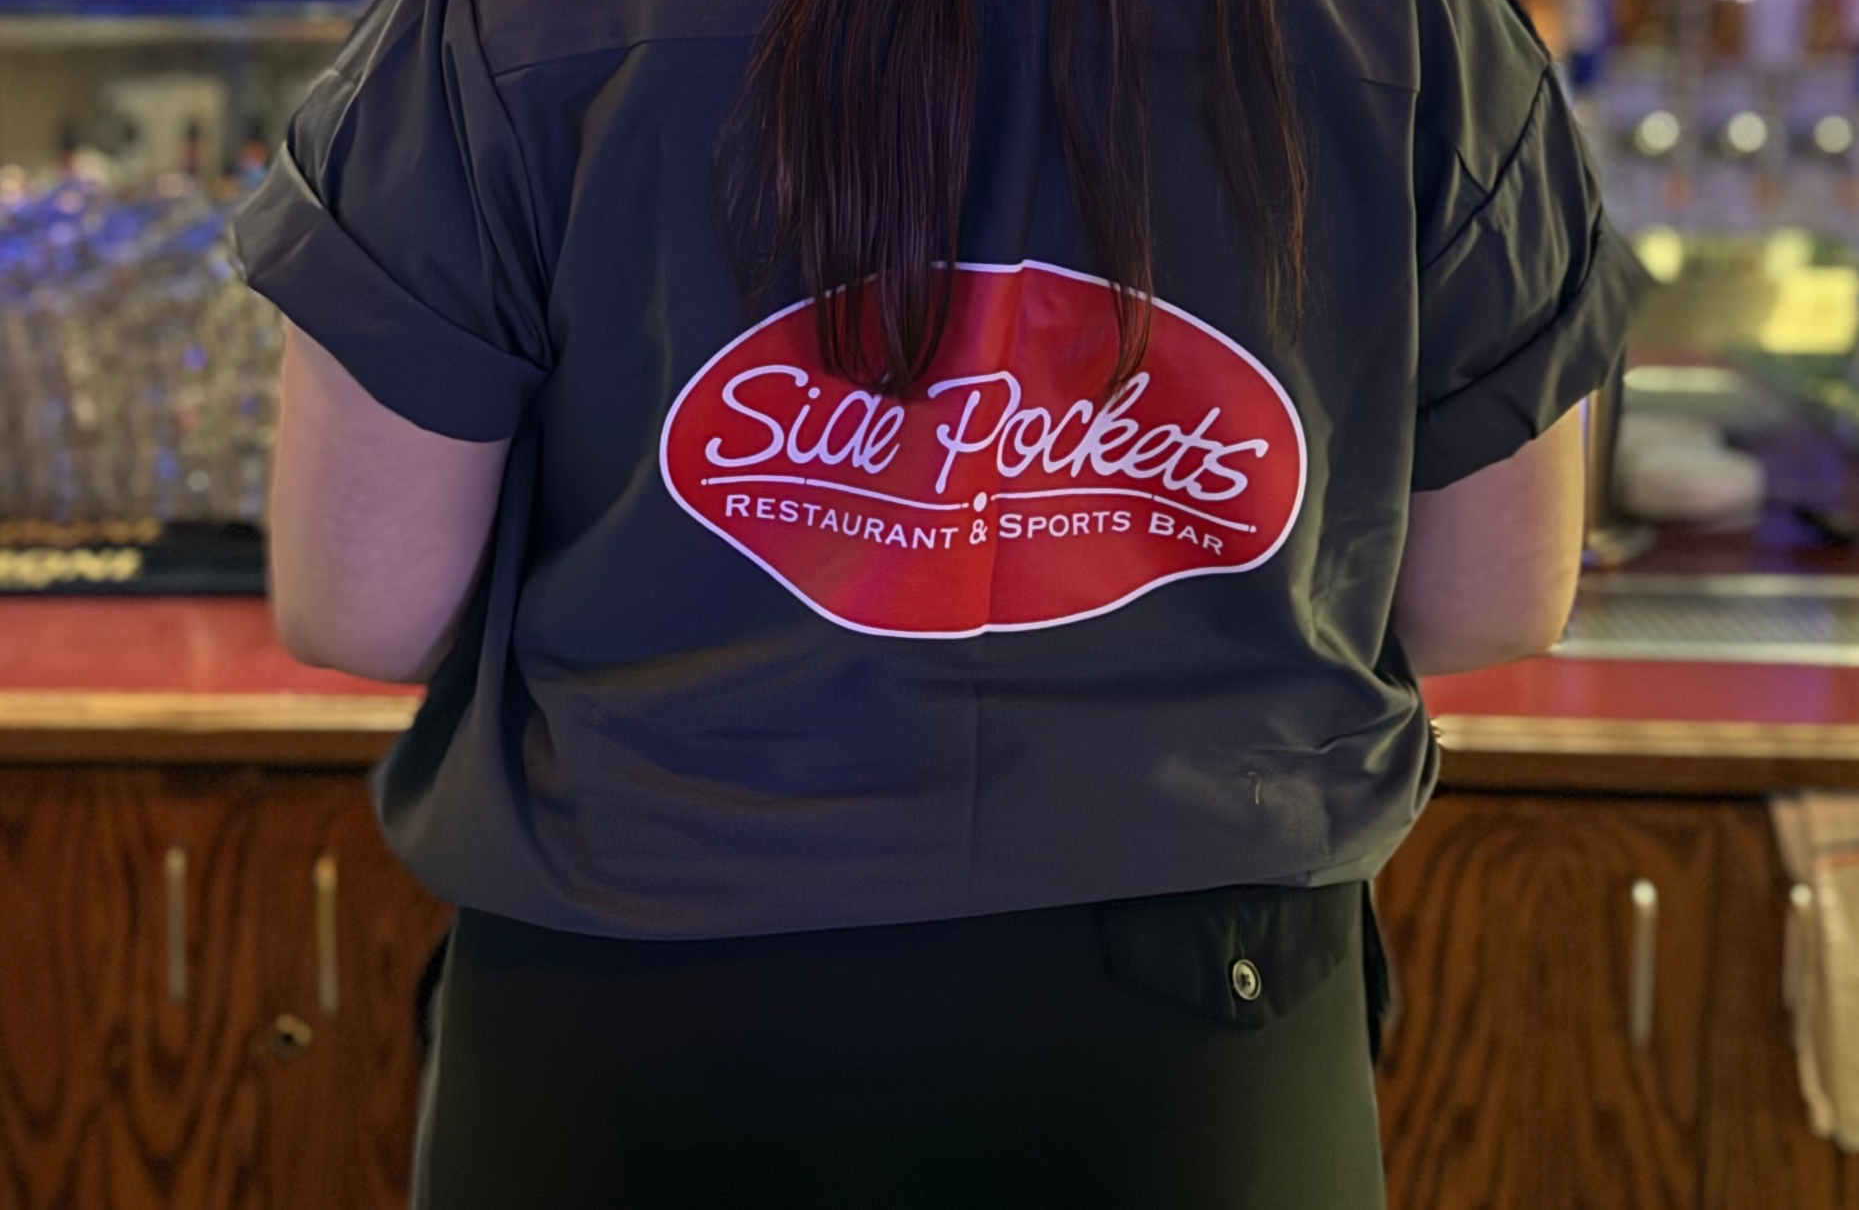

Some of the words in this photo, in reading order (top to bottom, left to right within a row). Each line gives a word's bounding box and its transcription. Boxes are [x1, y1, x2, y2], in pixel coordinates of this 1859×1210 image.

[704, 364, 905, 474] Side
[926, 370, 1270, 501] Pockets
[724, 493, 959, 550] RESTAURANT
[968, 508, 989, 545] &
[998, 510, 1132, 539] SPORTS
[1148, 511, 1224, 556] BAR
